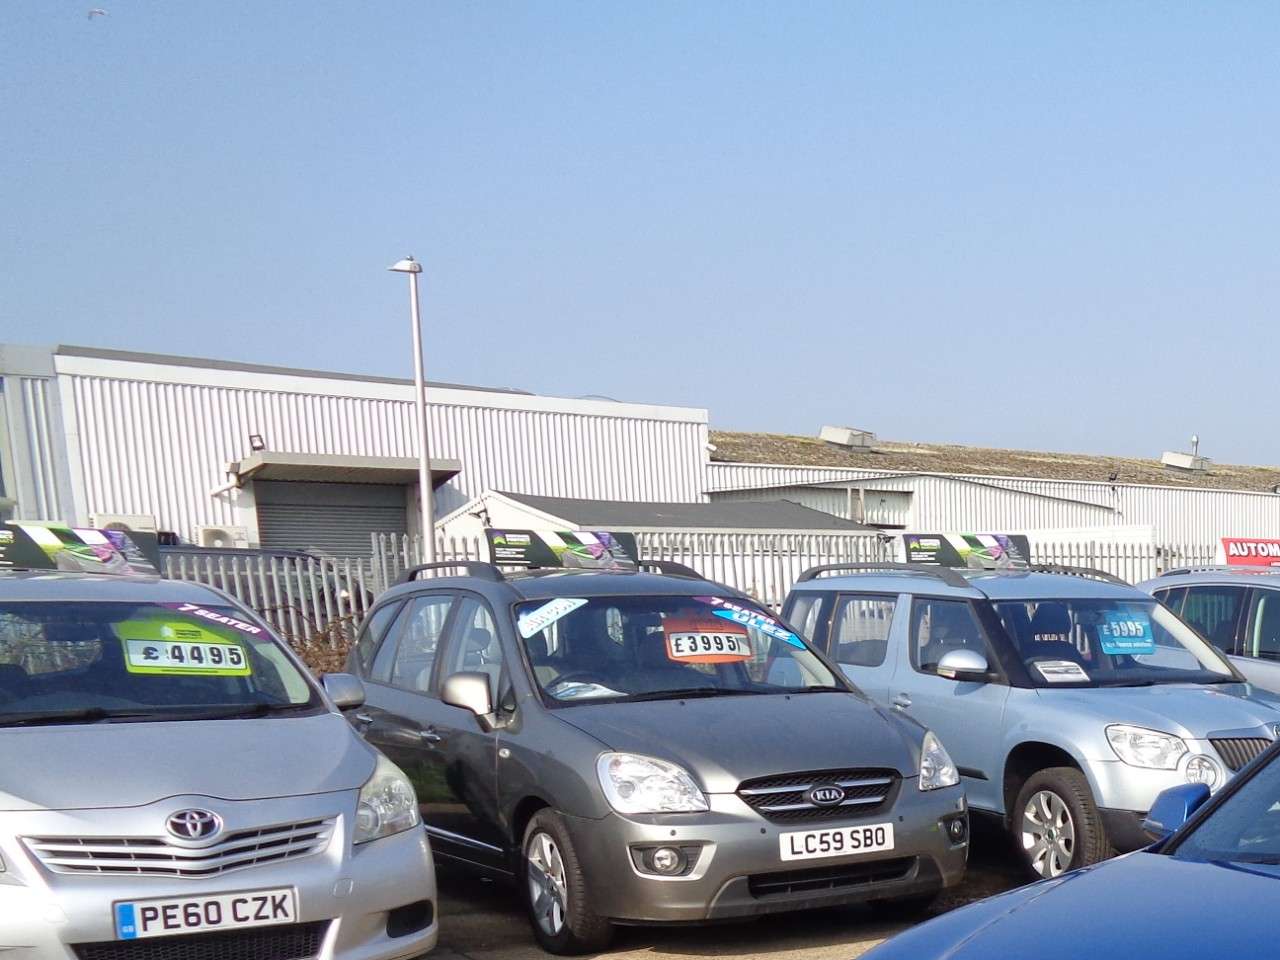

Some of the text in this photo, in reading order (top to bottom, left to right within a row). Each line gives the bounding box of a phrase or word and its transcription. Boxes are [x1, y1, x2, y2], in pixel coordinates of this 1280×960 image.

[711, 597, 724, 605] 7
[178, 603, 200, 611] 7
[194, 609, 261, 634] SEATER
[674, 635, 737, 652] £3995
[815, 789, 841, 801] KIA
[790, 827, 886, 855] LC59 SBO
[140, 894, 289, 932] PE60 CZK
